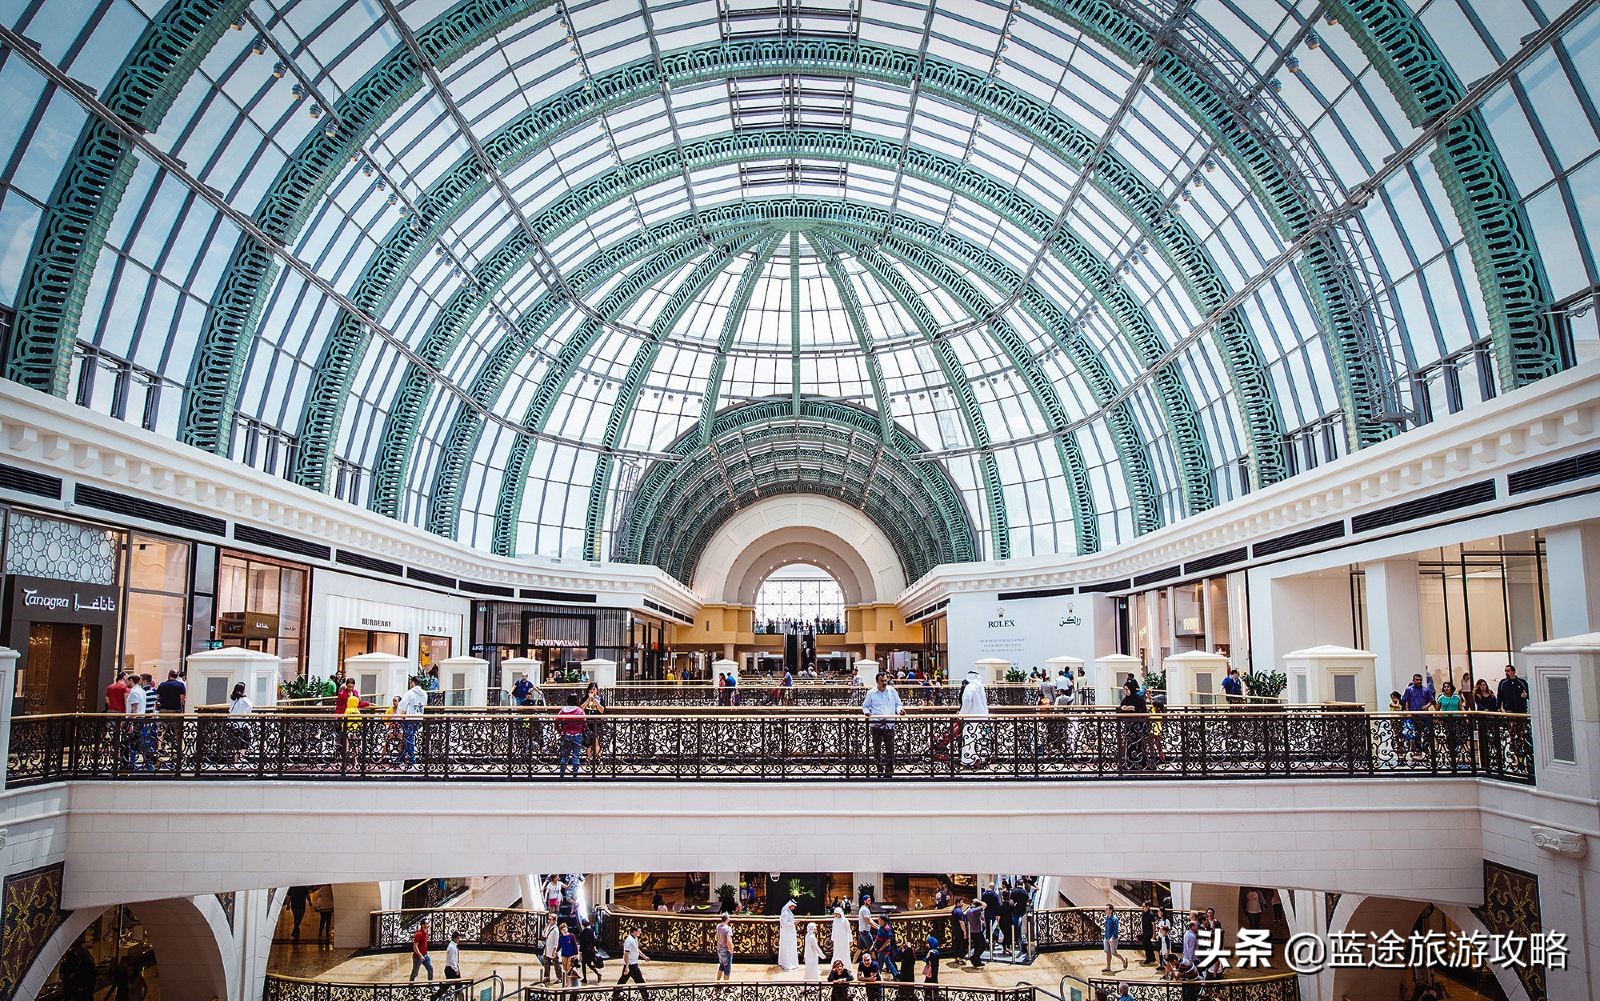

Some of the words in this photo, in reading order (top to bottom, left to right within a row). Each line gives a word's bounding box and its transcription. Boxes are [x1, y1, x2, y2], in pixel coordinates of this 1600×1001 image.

[23, 588, 69, 610] Tanagra
[361, 617, 392, 628] BURBERRY
[987, 619, 1016, 629] ROLEX
